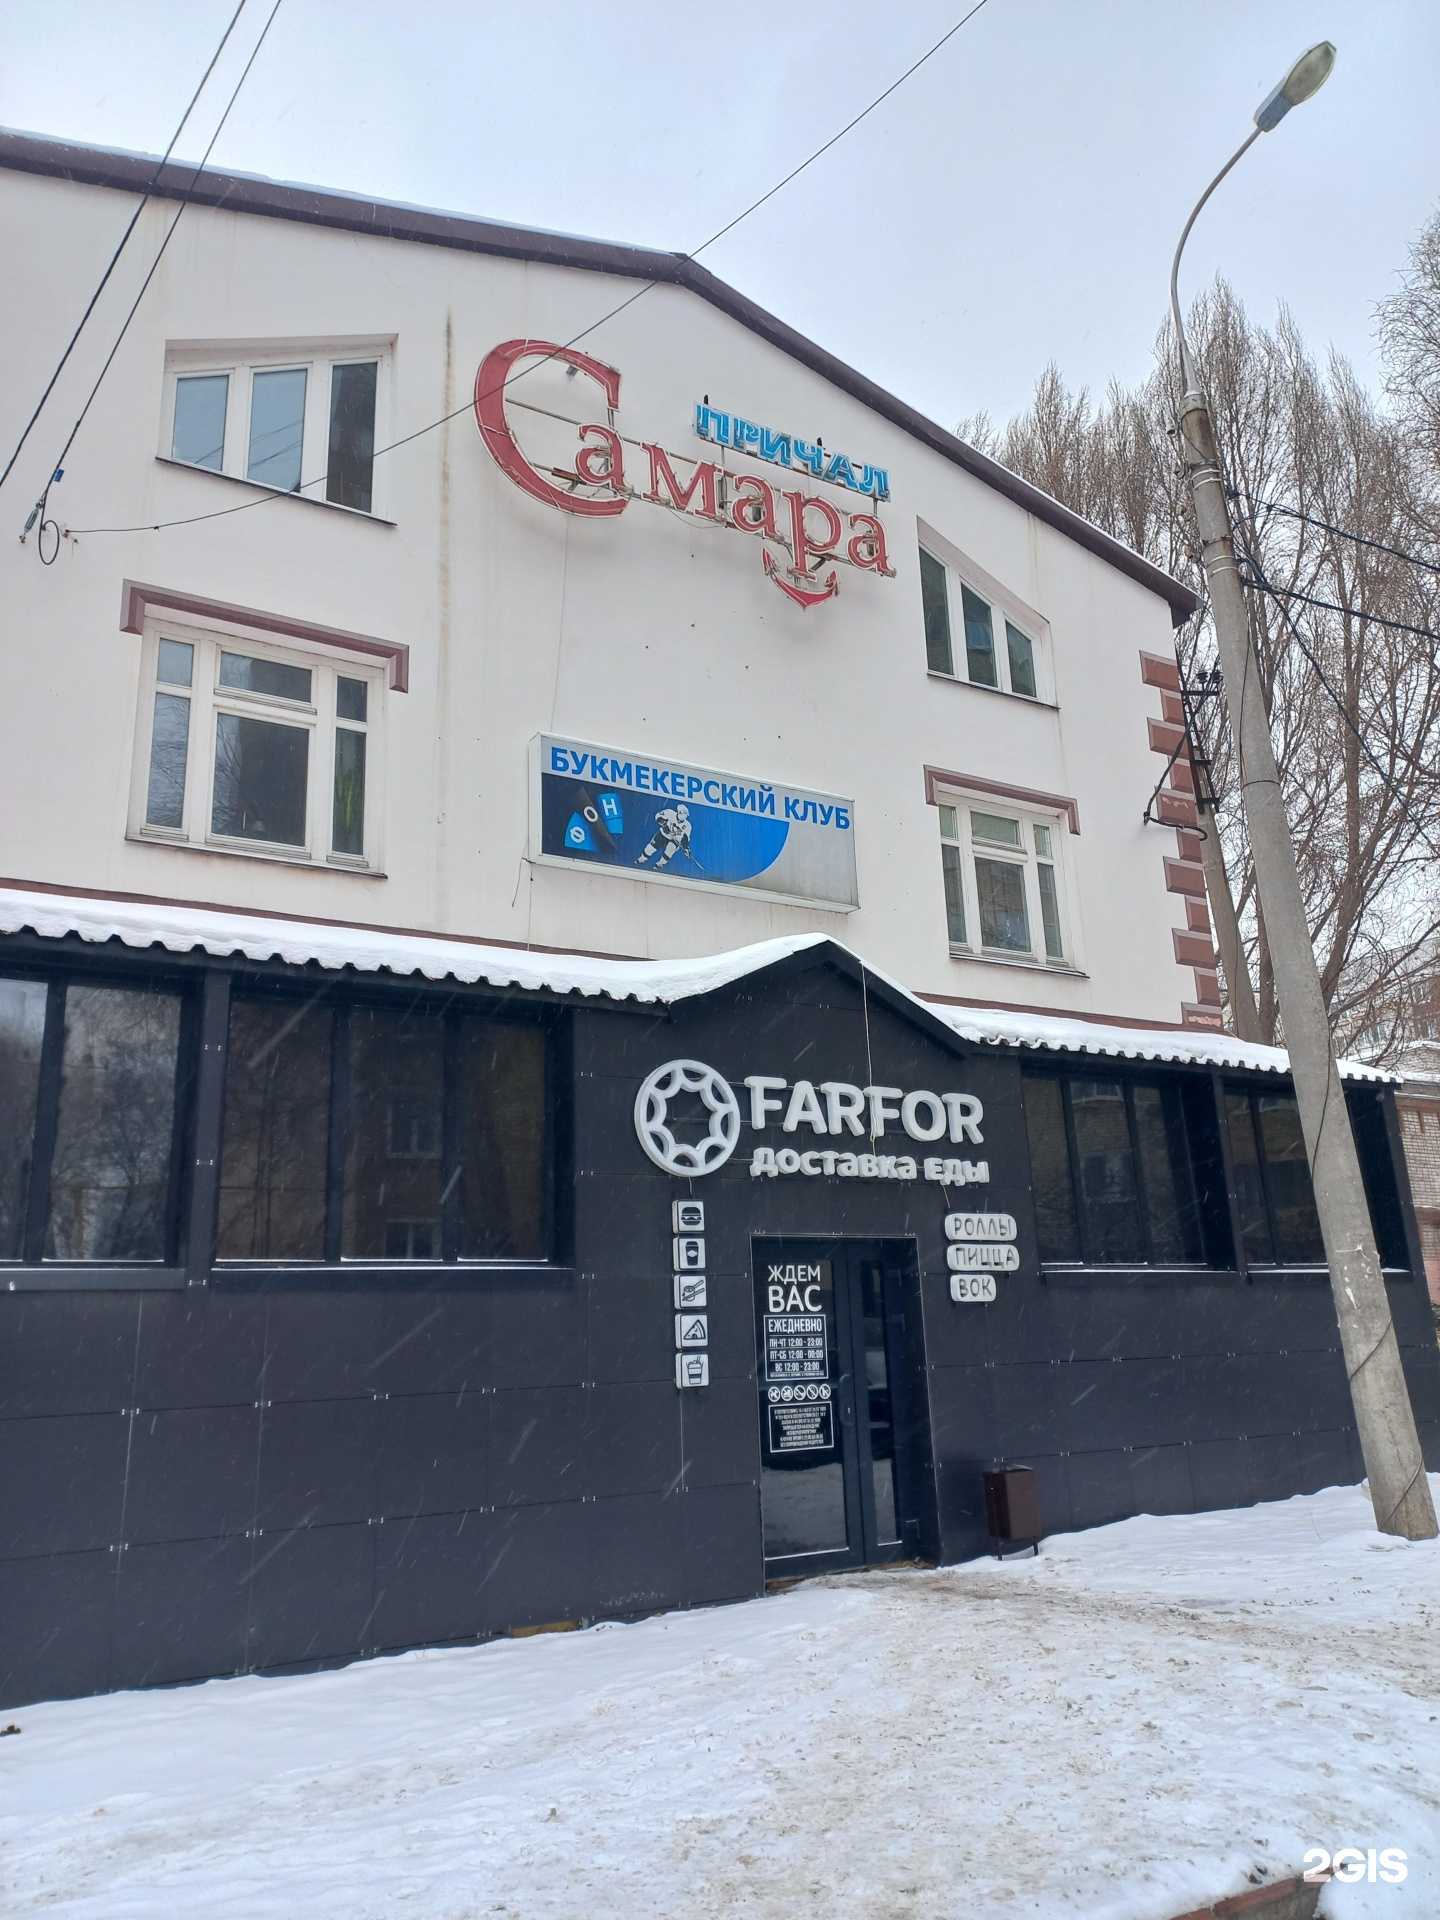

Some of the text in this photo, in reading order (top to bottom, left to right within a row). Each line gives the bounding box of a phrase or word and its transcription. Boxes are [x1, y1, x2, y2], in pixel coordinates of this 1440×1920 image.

[474, 338, 896, 582] Самара
[695, 403, 891, 500] ПРИЧАЛ
[551, 746, 850, 830] БУКМЕКЕРСКИЙ КЛУБ
[744, 1076, 984, 1144] FARFOR
[924, 1157, 990, 1186] еды
[954, 1217, 1012, 1236] РОЛЛЫ
[956, 1247, 1015, 1268] ПИЦЦА
[767, 1265, 821, 1285] ЖДЕМ
[959, 1278, 993, 1297] ВОК
[768, 1285, 822, 1312] ВАС
[768, 1318, 822, 1333] ЕЖЕДНЕВНО
